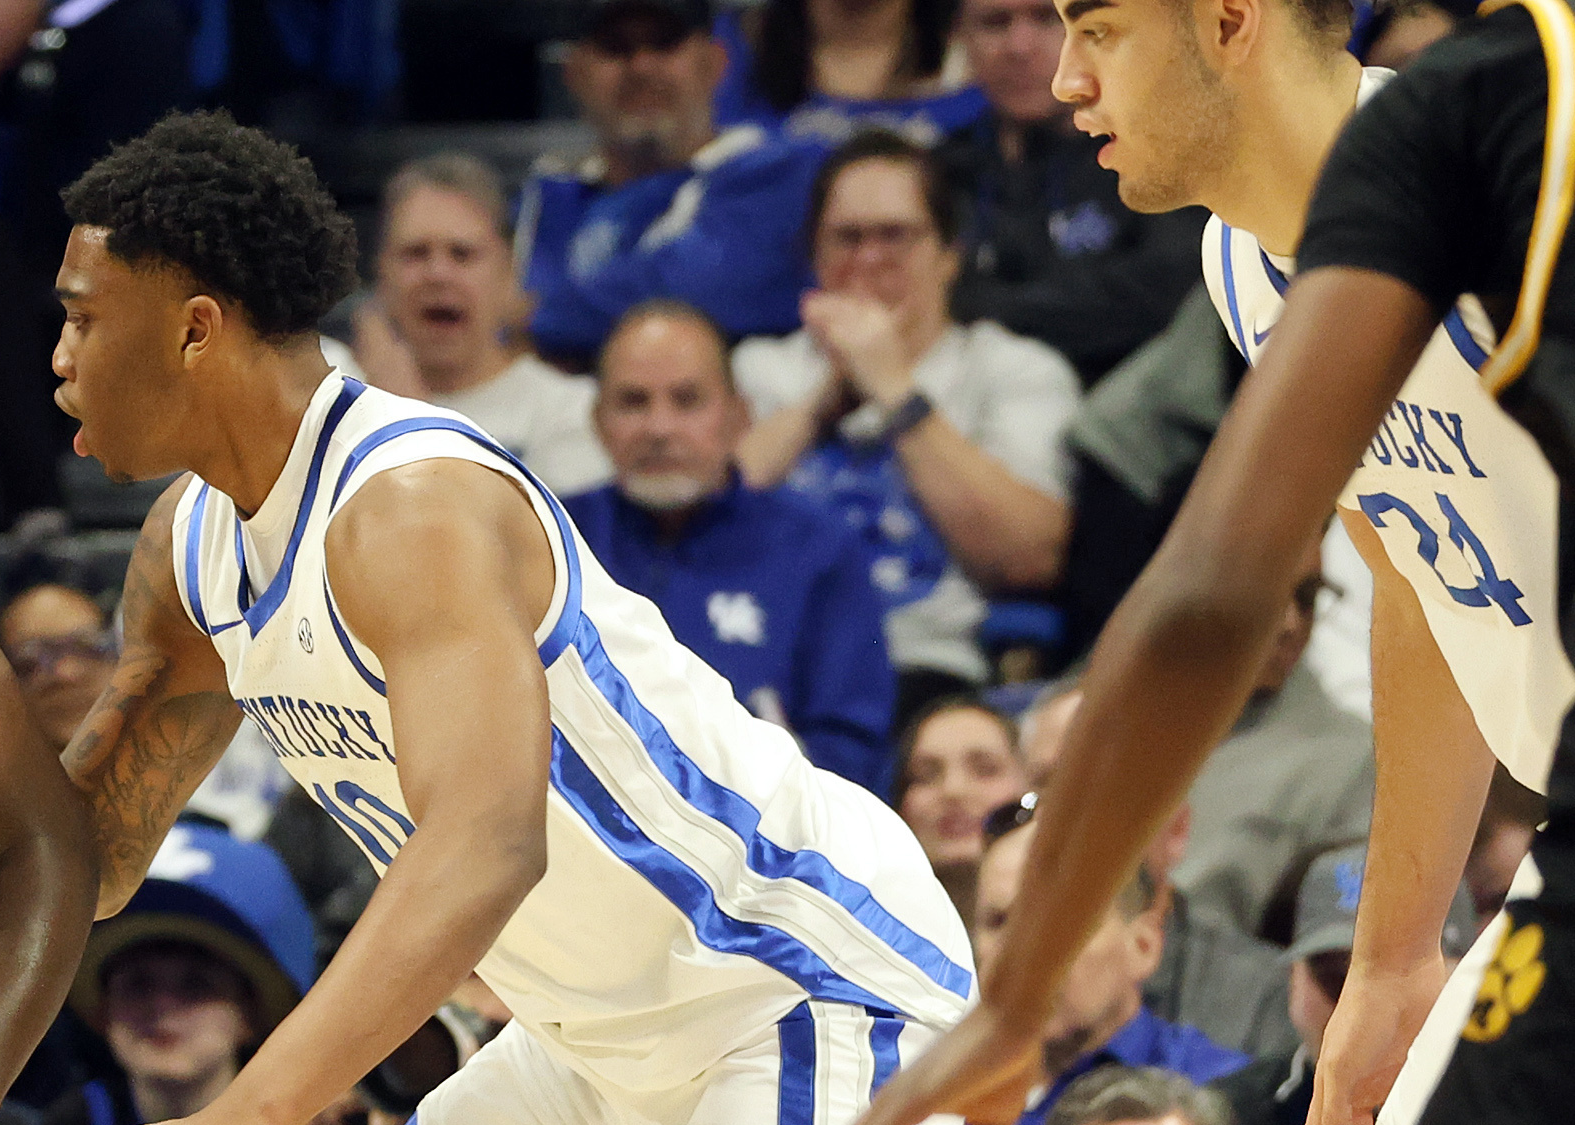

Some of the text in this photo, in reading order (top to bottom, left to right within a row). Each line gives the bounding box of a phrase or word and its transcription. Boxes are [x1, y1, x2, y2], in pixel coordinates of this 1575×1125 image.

[1357, 400, 1488, 478] UCKY
[1356, 491, 1534, 627] 24
[312, 779, 418, 867] 10
